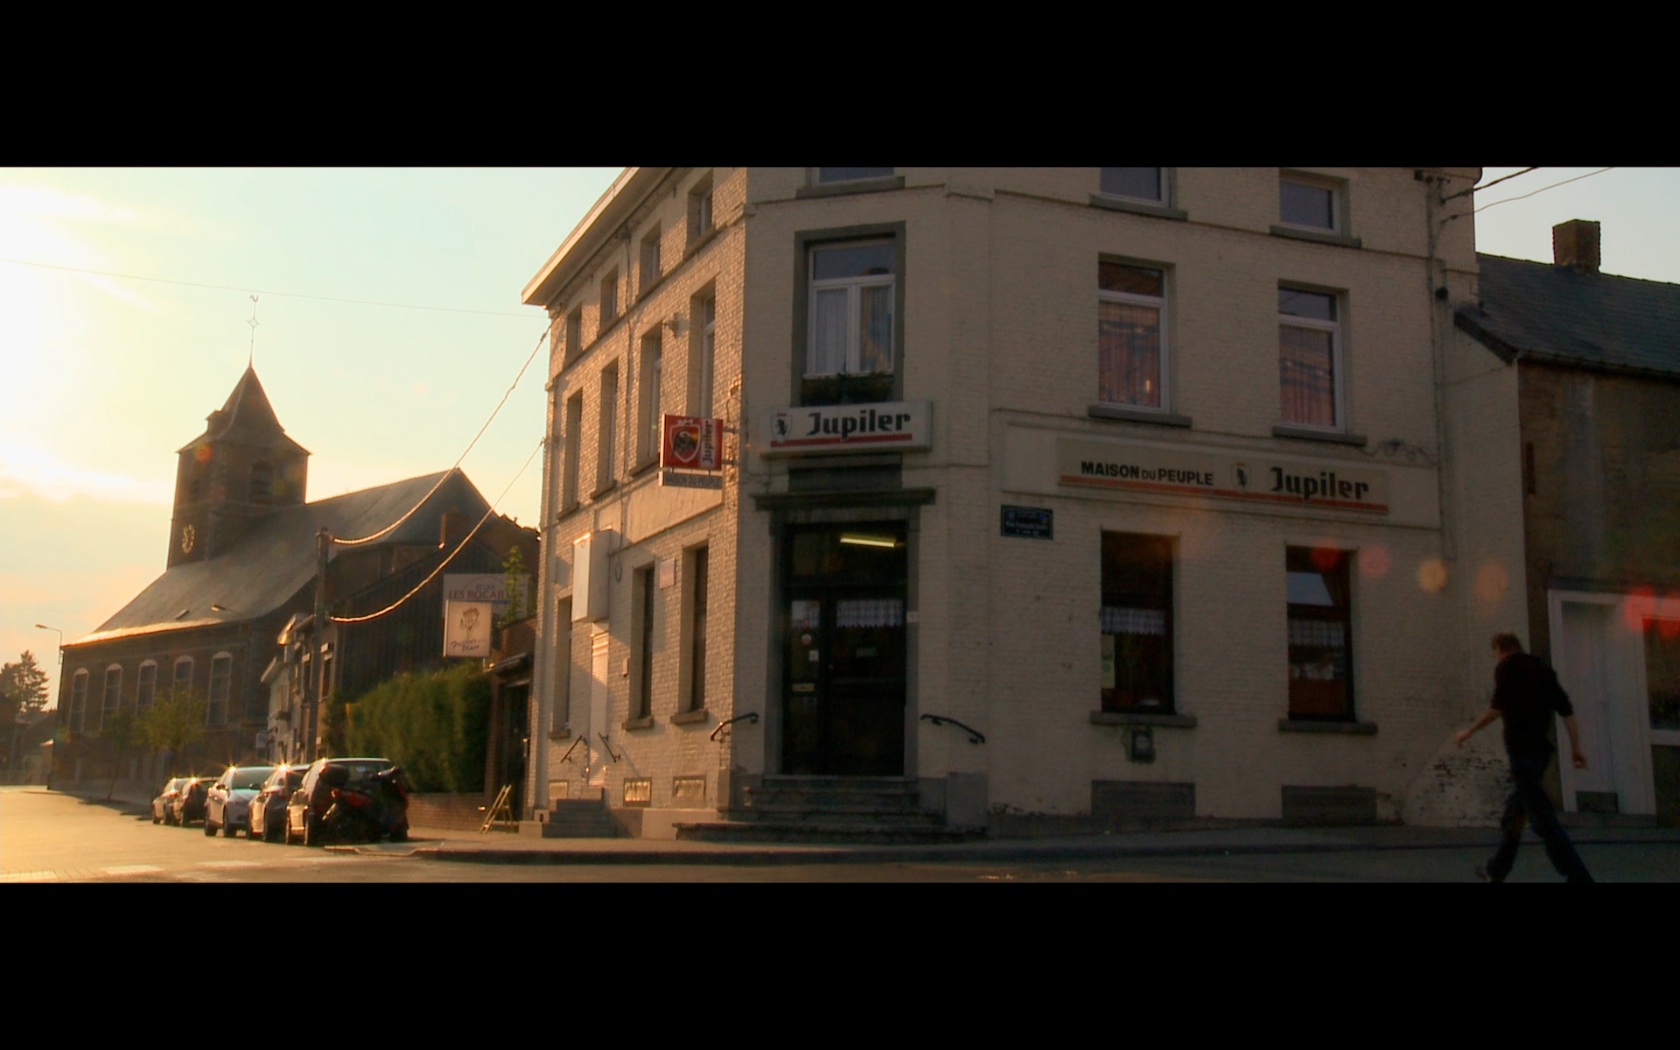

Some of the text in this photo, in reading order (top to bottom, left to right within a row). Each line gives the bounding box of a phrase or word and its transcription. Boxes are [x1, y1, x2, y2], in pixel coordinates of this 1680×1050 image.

[806, 409, 911, 439] Jupiler
[702, 420, 714, 464] Jupiler
[1081, 461, 1213, 486] MAISON DU PEUPLE
[1270, 466, 1369, 500] Jupiler
[448, 590, 465, 599] LES
